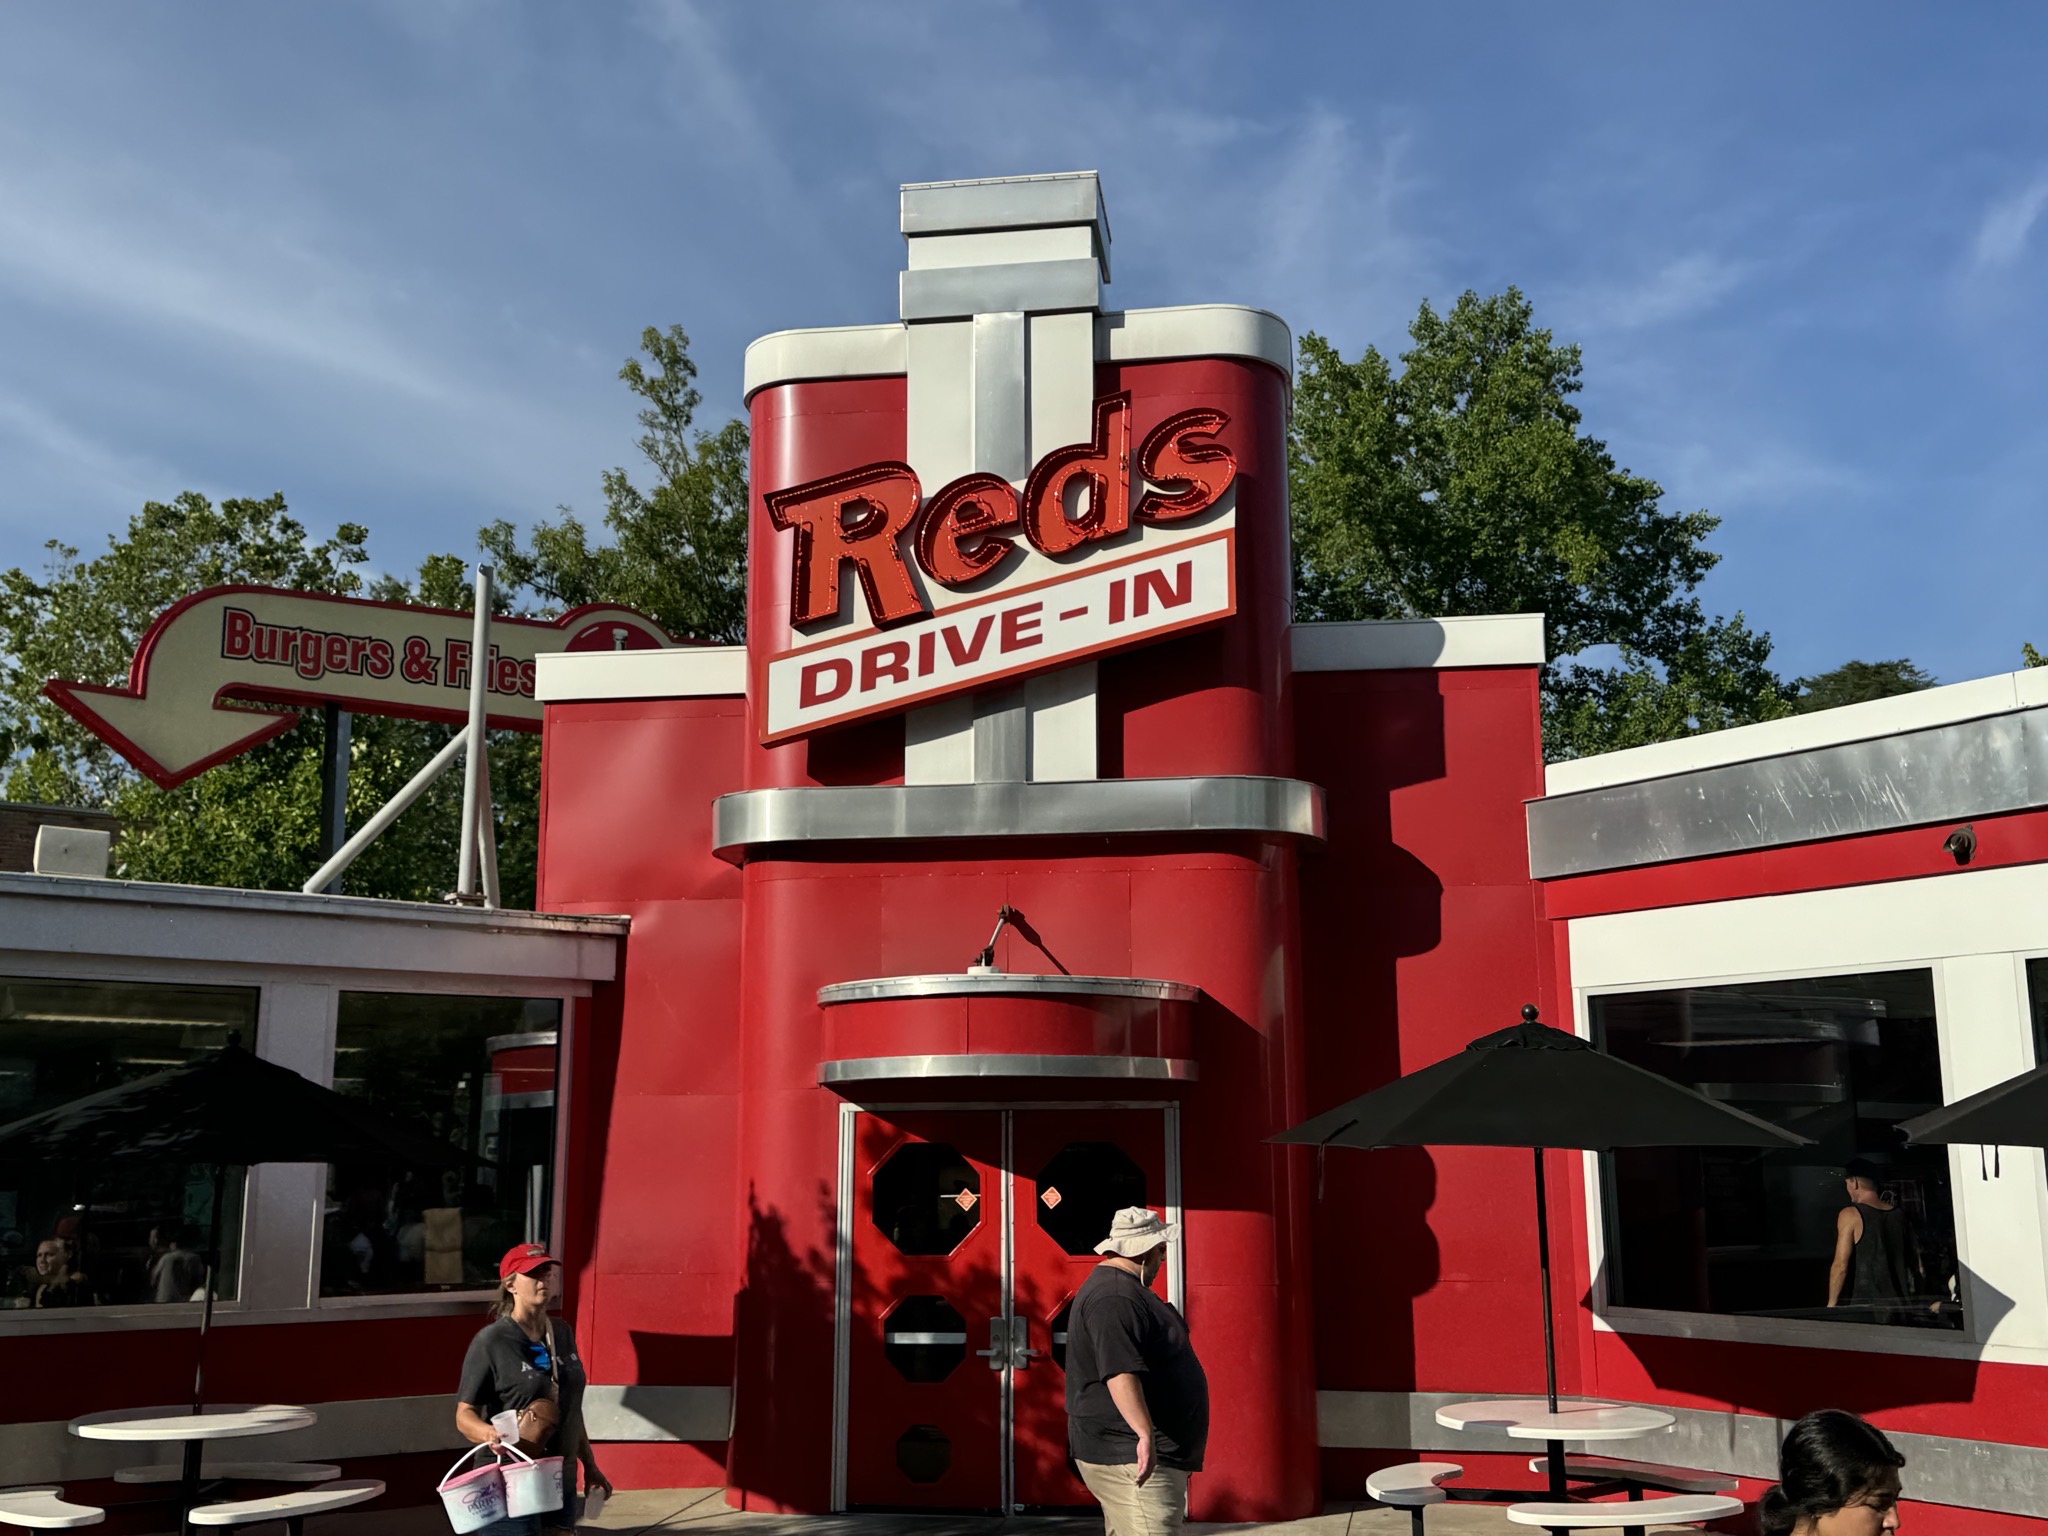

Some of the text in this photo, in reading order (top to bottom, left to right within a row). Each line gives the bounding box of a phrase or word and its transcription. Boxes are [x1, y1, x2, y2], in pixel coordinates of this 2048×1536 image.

[763, 390, 1237, 632] Reds
[221, 607, 536, 698] Burgers & Fies
